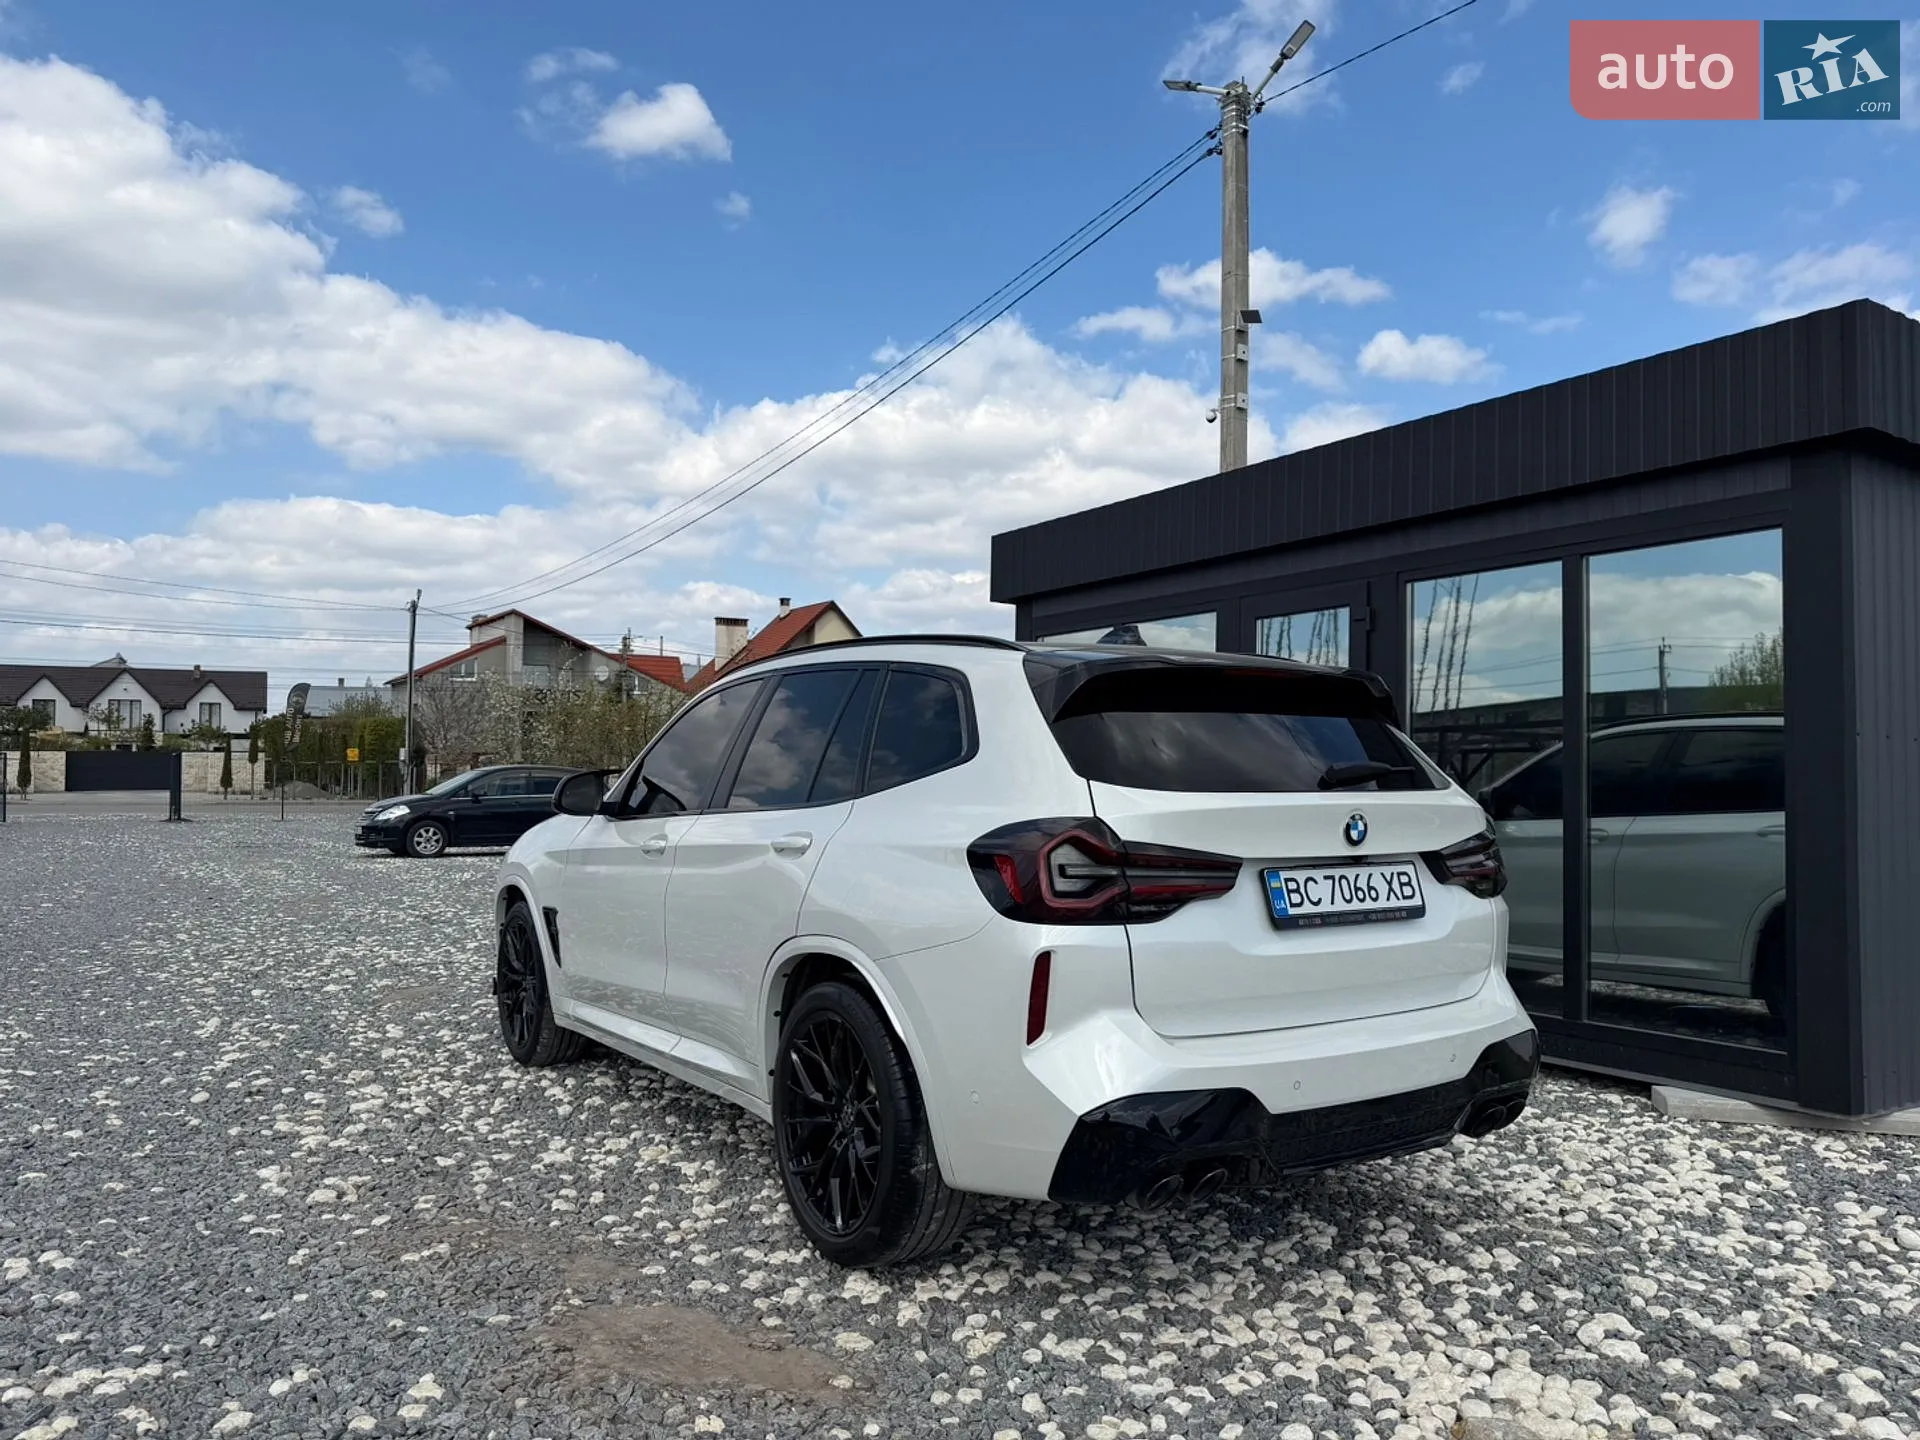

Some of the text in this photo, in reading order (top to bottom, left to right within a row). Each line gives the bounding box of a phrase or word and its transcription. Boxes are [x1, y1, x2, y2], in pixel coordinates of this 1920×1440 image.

[1285, 871, 1416, 908] BC 7066 XB
[1274, 900, 1287, 910] UA
